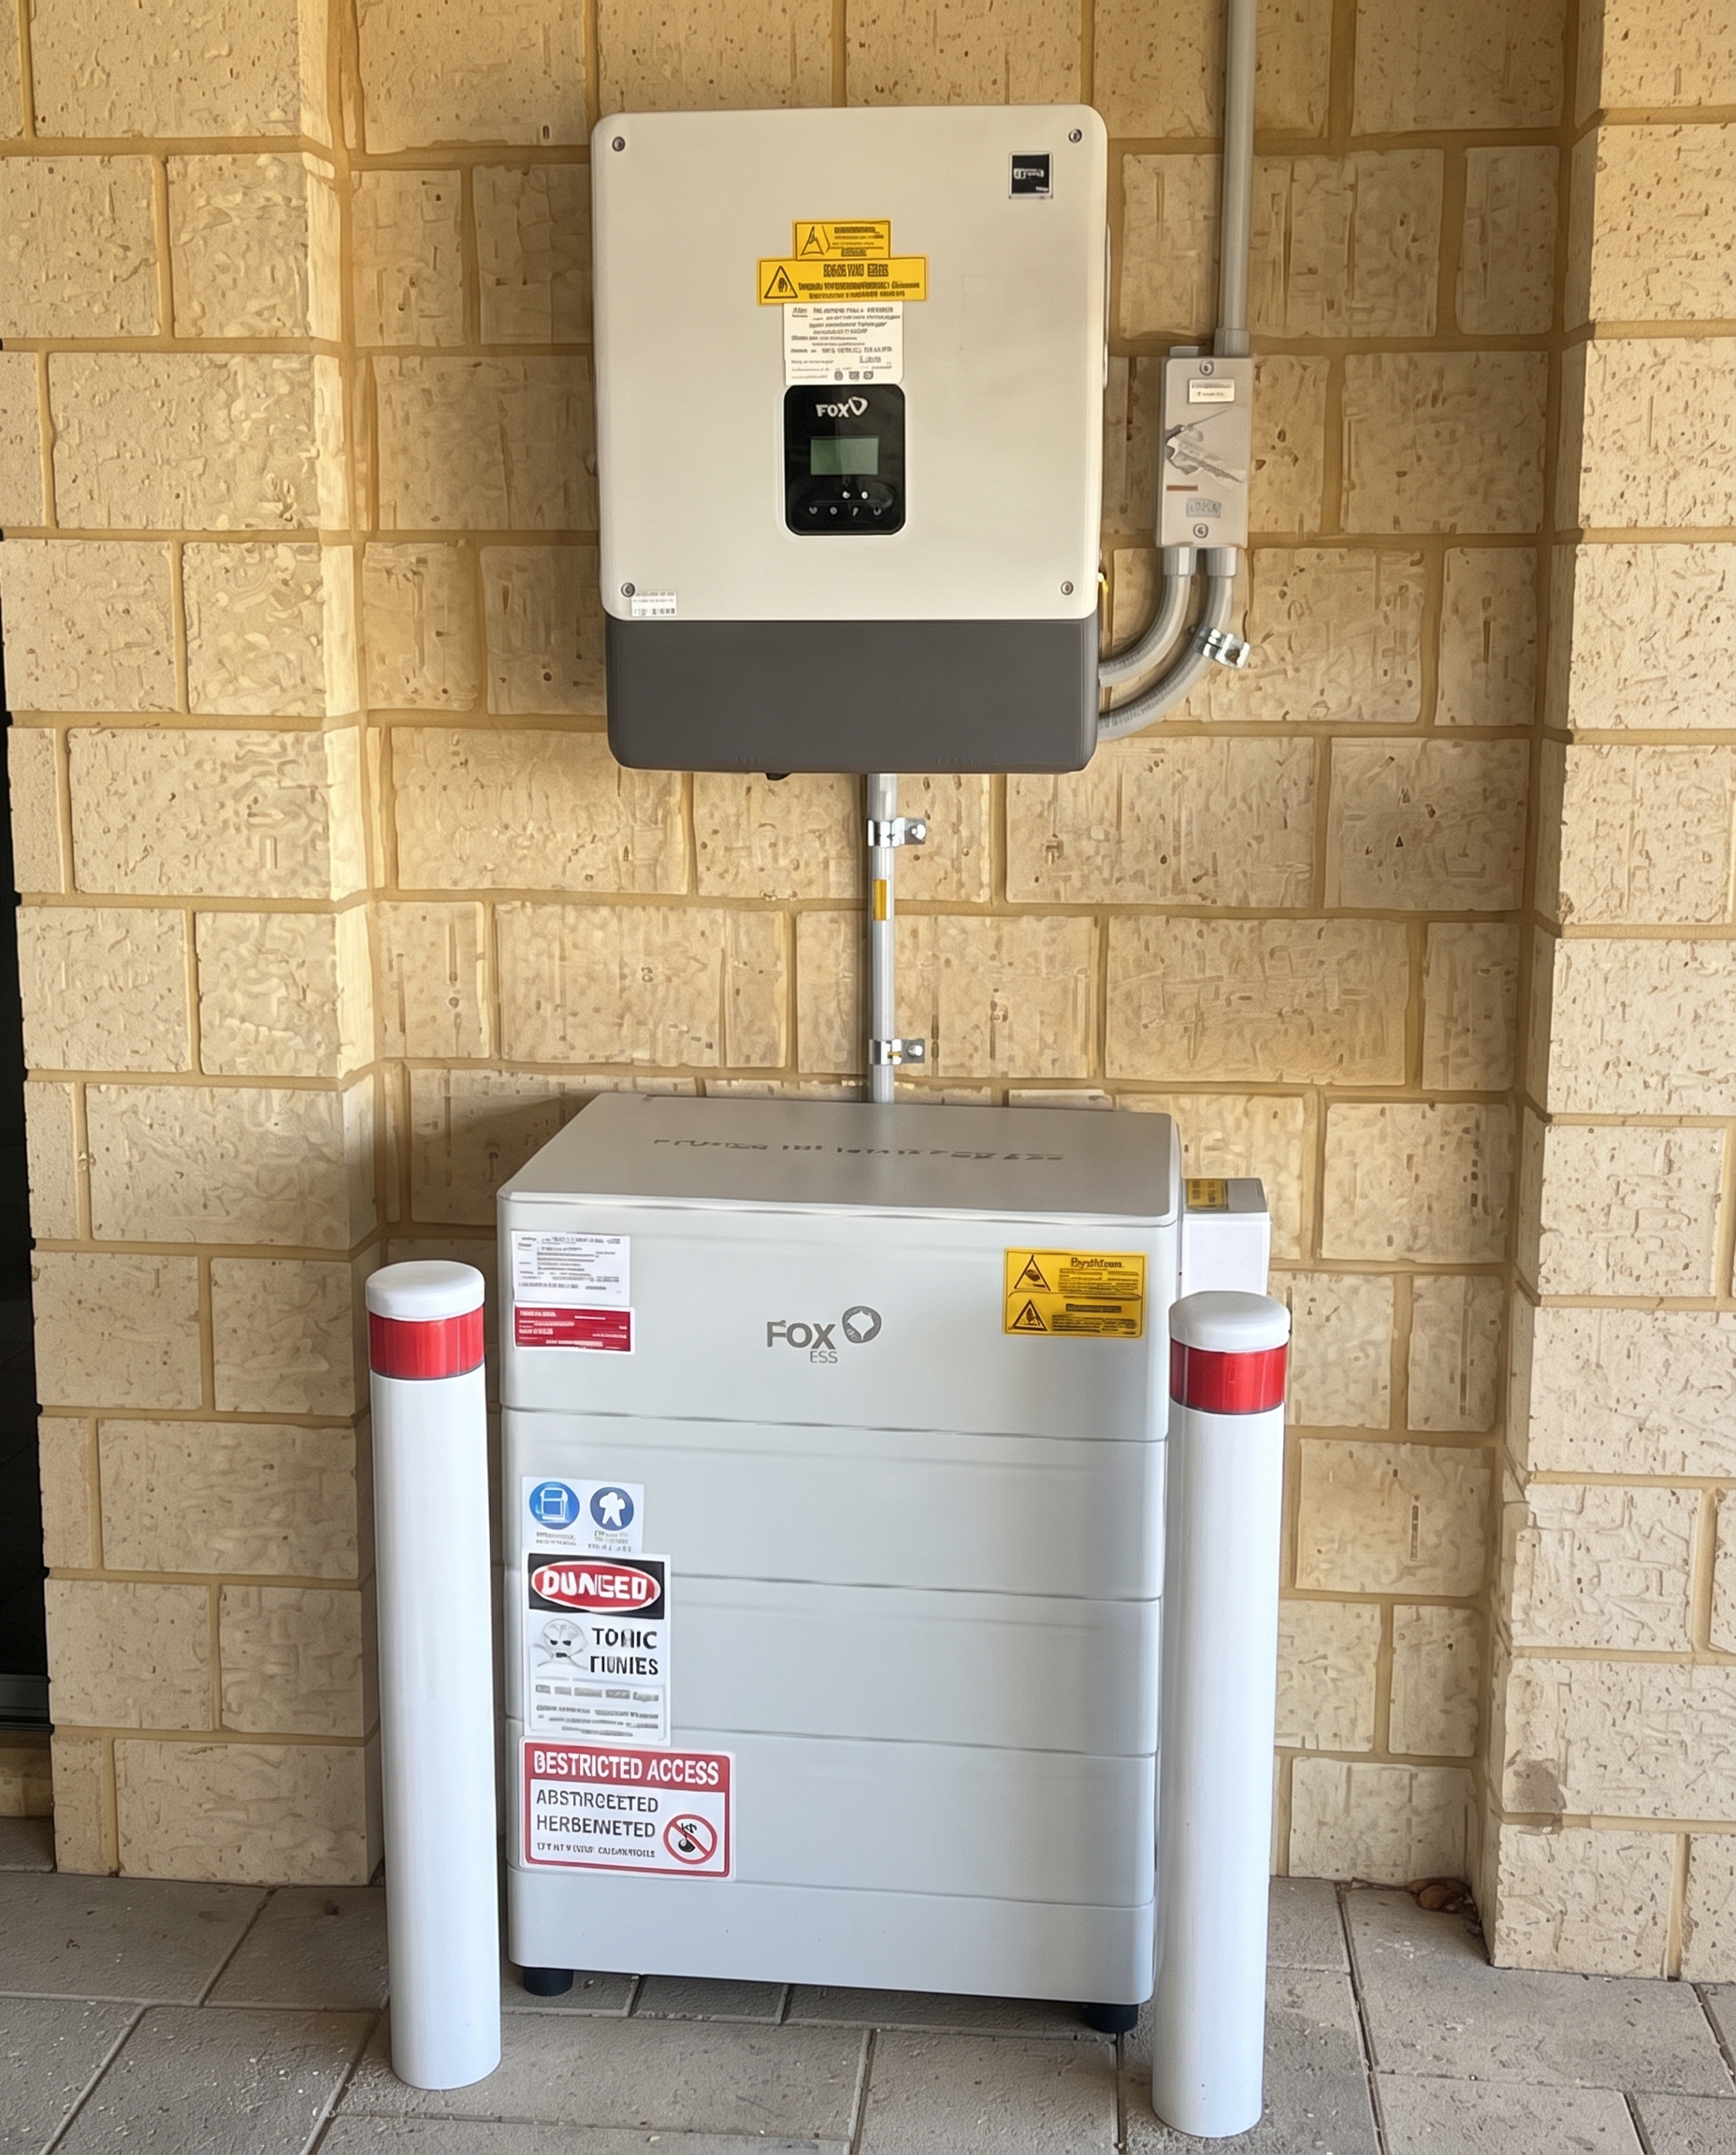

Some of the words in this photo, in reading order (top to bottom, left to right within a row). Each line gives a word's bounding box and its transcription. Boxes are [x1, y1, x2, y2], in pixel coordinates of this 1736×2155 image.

[767, 1320, 836, 1350] FOX
[810, 1351, 838, 1364] ESS
[646, 1759, 719, 1785] ACCESS
